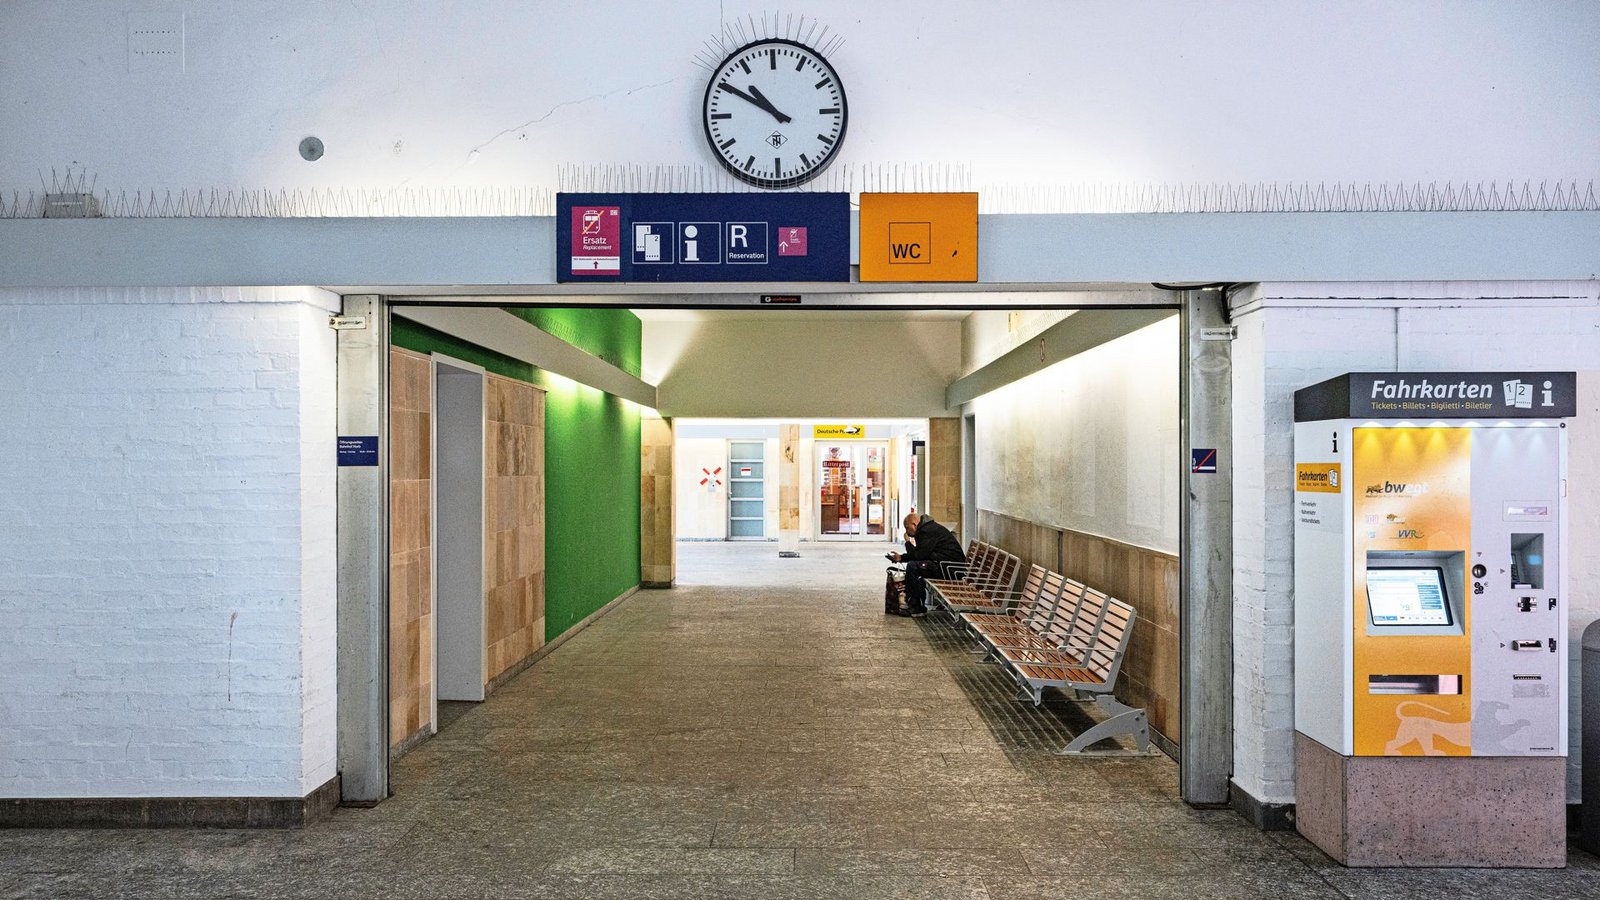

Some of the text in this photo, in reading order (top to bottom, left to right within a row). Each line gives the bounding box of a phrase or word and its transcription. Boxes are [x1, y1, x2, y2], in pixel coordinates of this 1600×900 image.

[583, 236, 607, 245] Ersatz
[731, 225, 748, 248] R
[729, 252, 765, 260] Reservation
[892, 243, 921, 259] WC
[1371, 379, 1493, 399] Fahrkarten
[1371, 401, 1493, 412] Tickets Billets Biglietti Biletler
[1299, 471, 1328, 481] Fahrkarten
